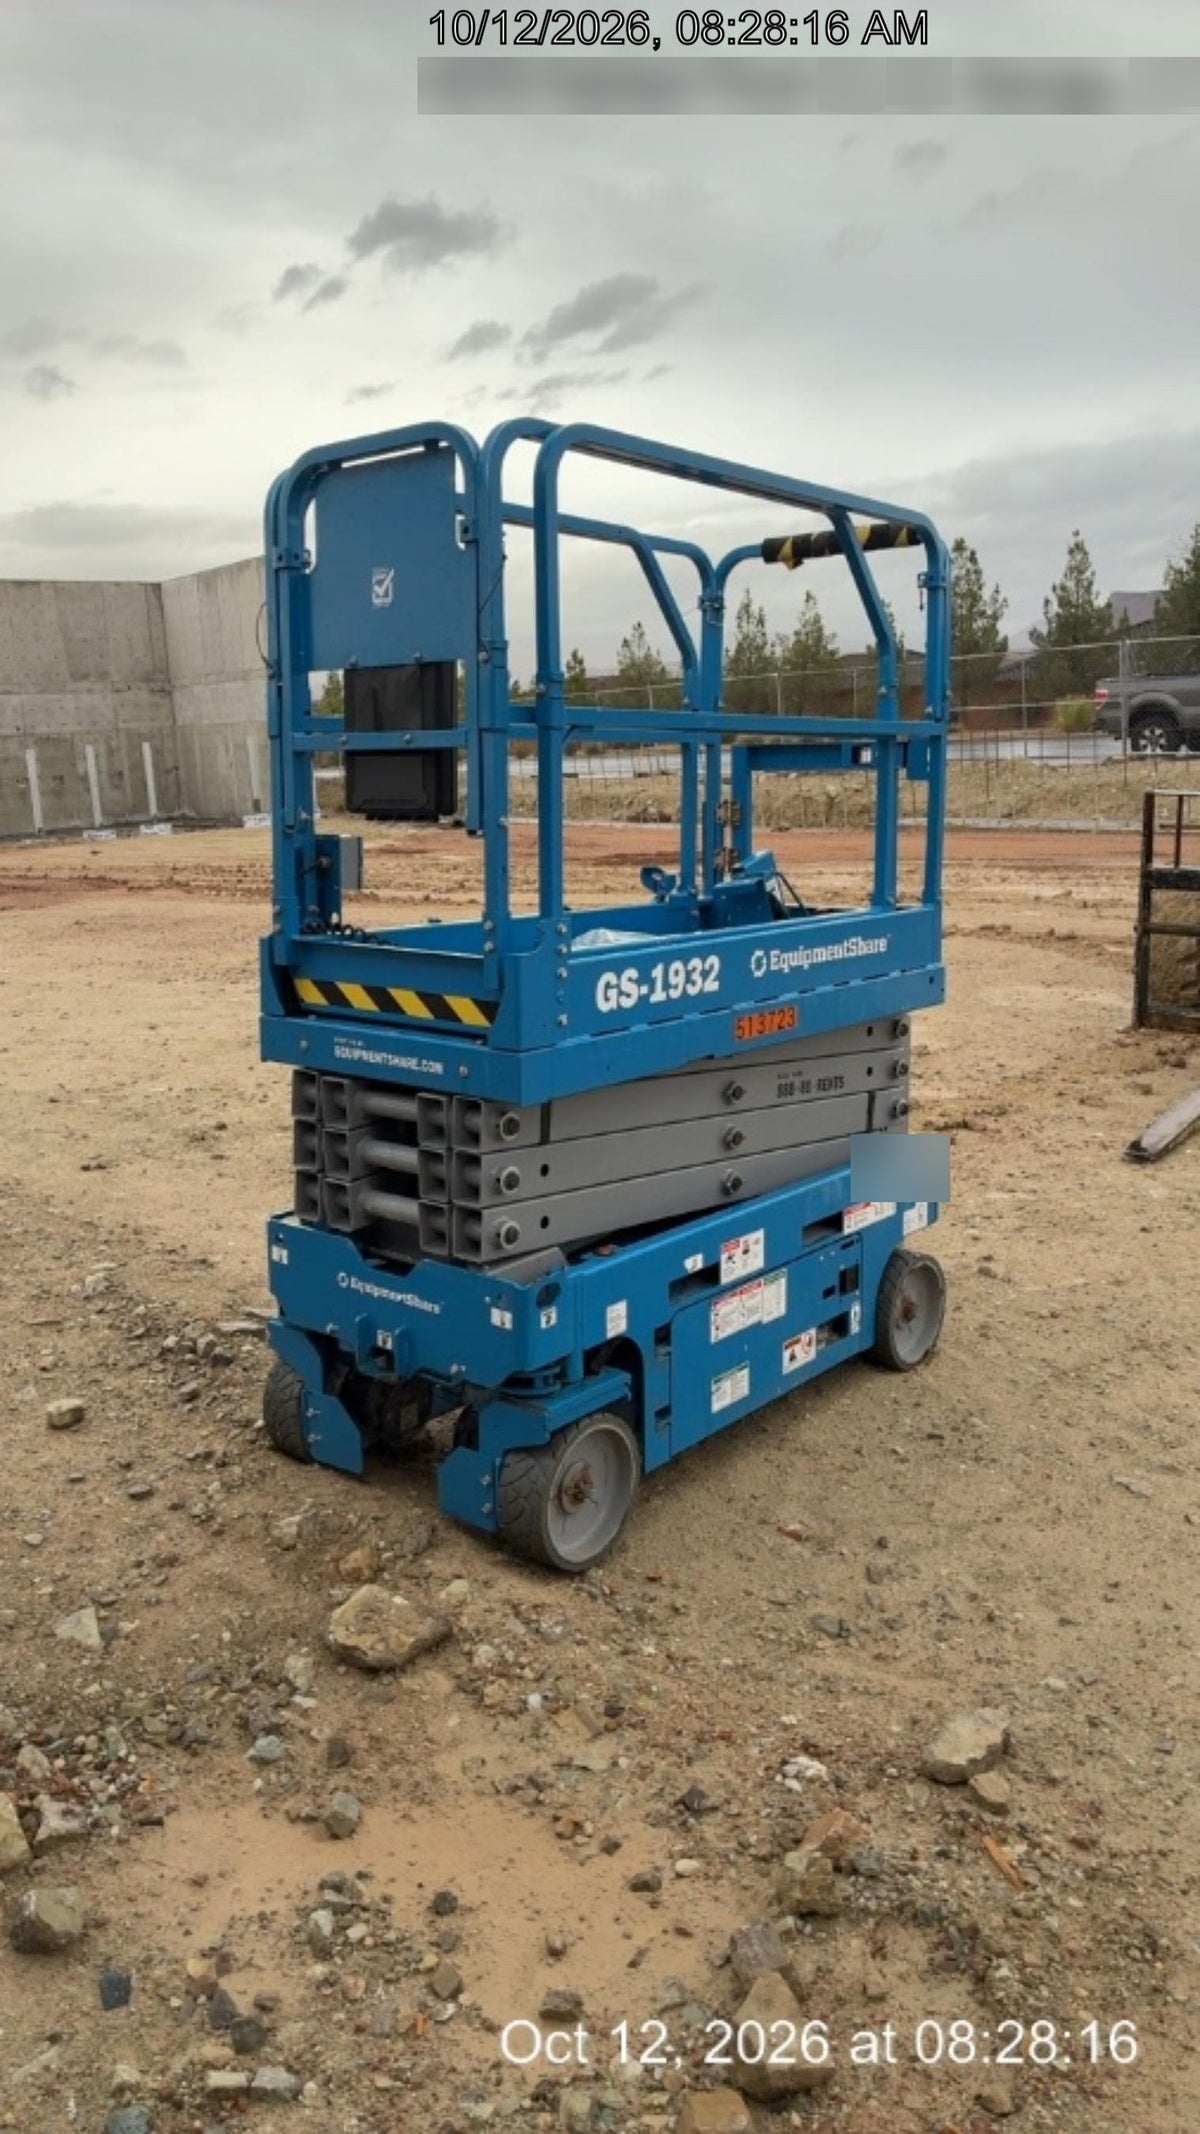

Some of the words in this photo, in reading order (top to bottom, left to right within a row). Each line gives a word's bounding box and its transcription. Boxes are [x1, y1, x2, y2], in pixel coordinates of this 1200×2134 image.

[769, 936, 888, 973] EquipmentShare
[595, 954, 721, 1013] GS-1932
[736, 1006, 796, 1040] 513723
